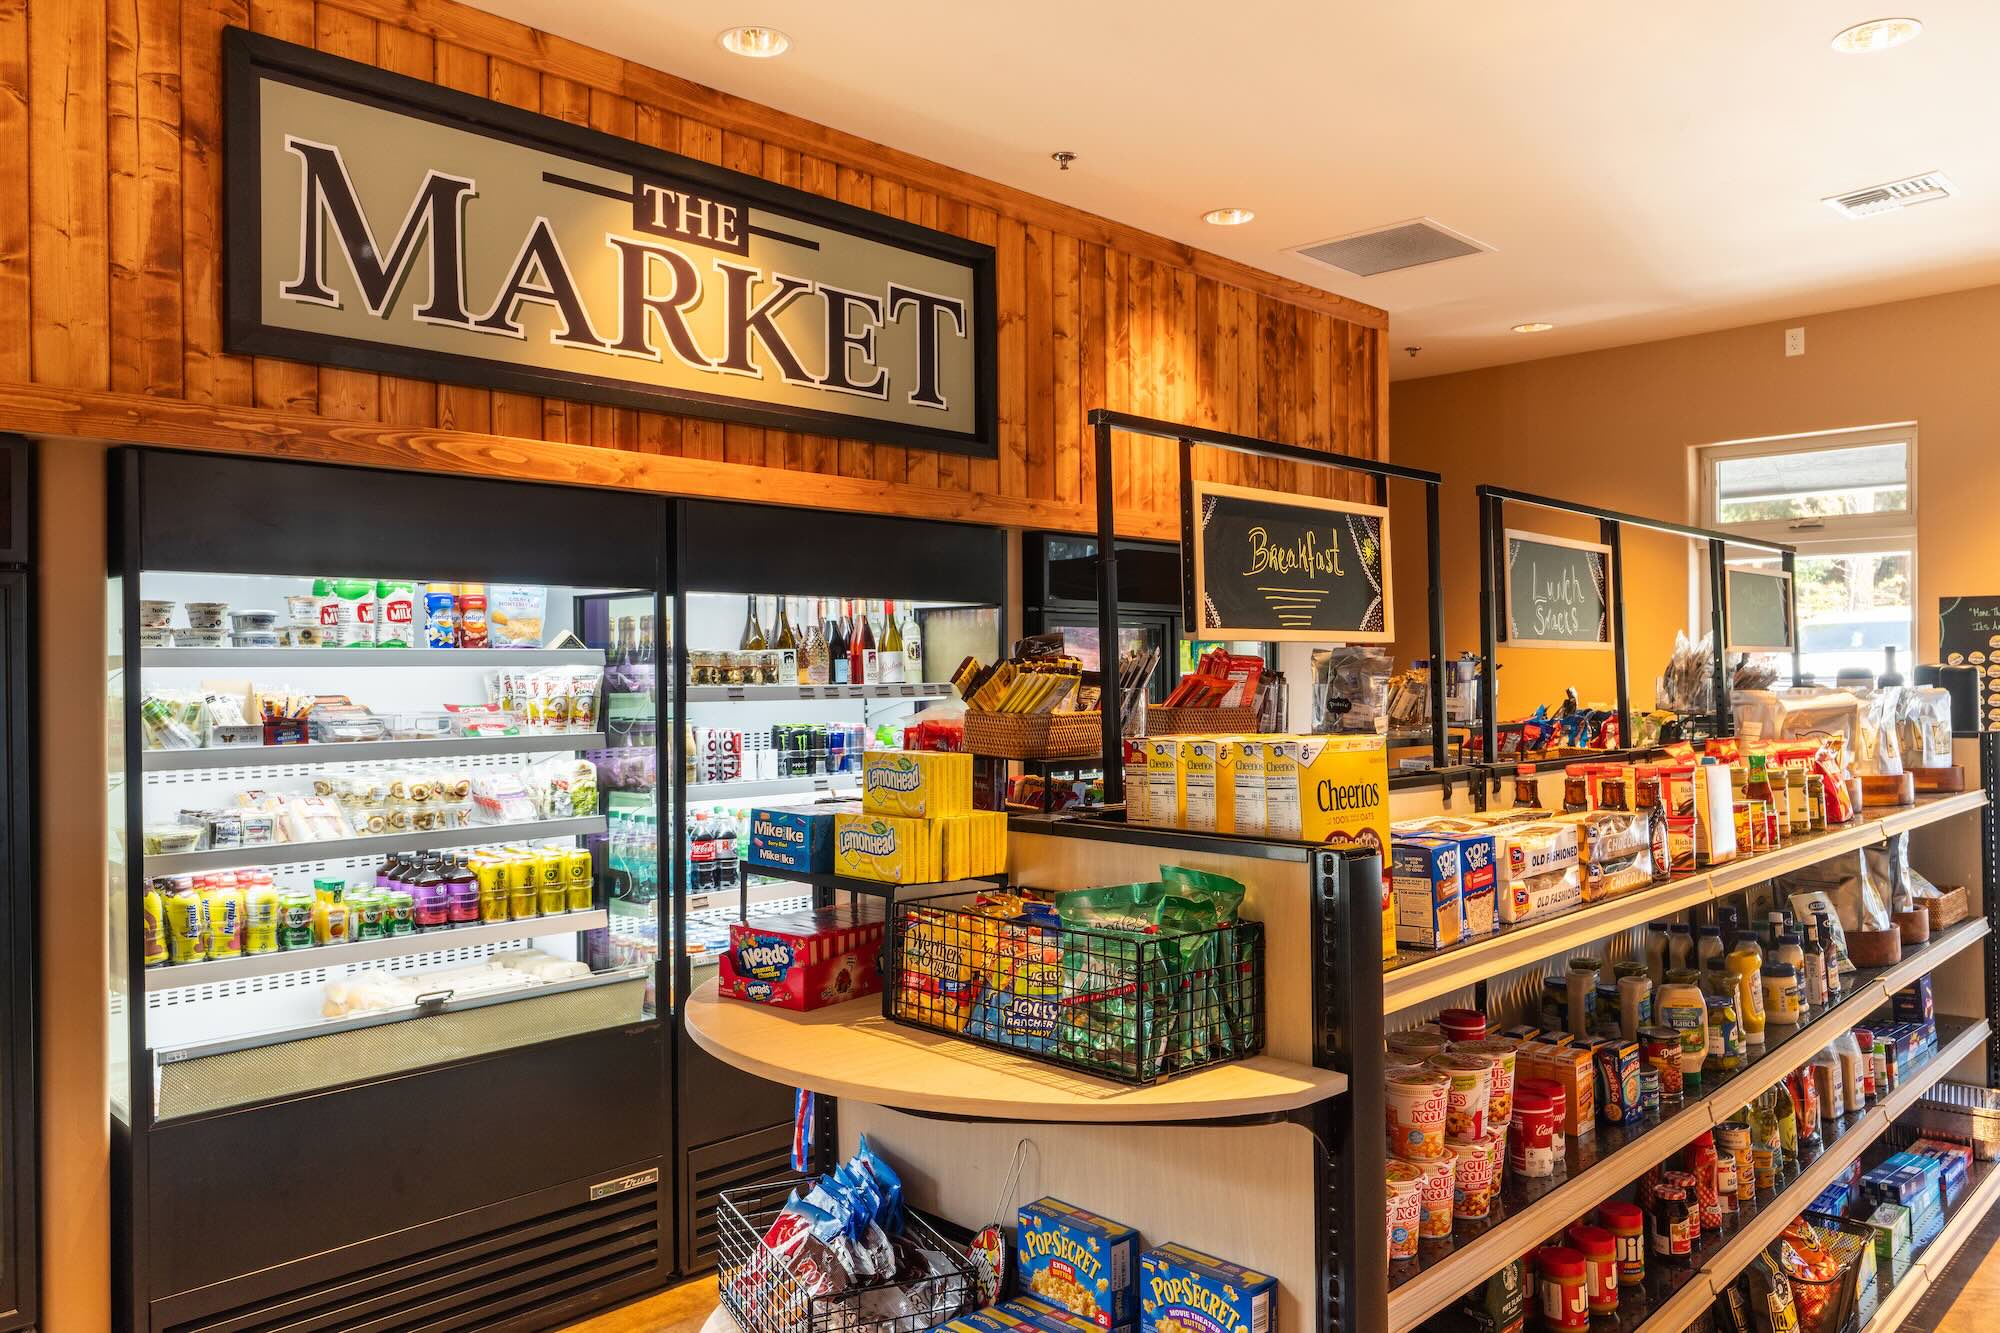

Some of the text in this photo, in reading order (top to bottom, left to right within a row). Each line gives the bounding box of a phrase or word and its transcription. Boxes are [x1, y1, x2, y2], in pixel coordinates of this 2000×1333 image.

[642, 181, 741, 247] THE
[278, 133, 966, 412] MARKET
[1243, 527, 1344, 579] Breakfast
[1533, 561, 1584, 605] Lunch
[723, 729, 735, 781] COSTA
[1150, 759, 1174, 769] Cheerios
[1187, 760, 1213, 770] Cheerios
[1236, 760, 1264, 771] Cheerios
[1266, 762, 1296, 773] Cheerios
[1317, 779, 1380, 812] Cheerios
[754, 821, 804, 843] Mike Ike
[760, 849, 795, 865] Mike Ike
[1532, 845, 1578, 867] OLD FSHIONED
[1537, 885, 1581, 908] OLD FASHIONED
[224, 900, 236, 934] Nesquik
[912, 929, 964, 964] Werther's
[922, 952, 960, 980] Original
[1028, 970, 1061, 982] JOLLY
[1007, 999, 1061, 1020] JOLLY
[1007, 1018, 1054, 1030] RANCHER
[1464, 1160, 1489, 1172] CUP
[1430, 1178, 1455, 1190] CUP
[1052, 1260, 1072, 1275] EXTRA
[1169, 1308, 1221, 1333] MOVIE THEATER
[1183, 1317, 1207, 1333] BUTTER
